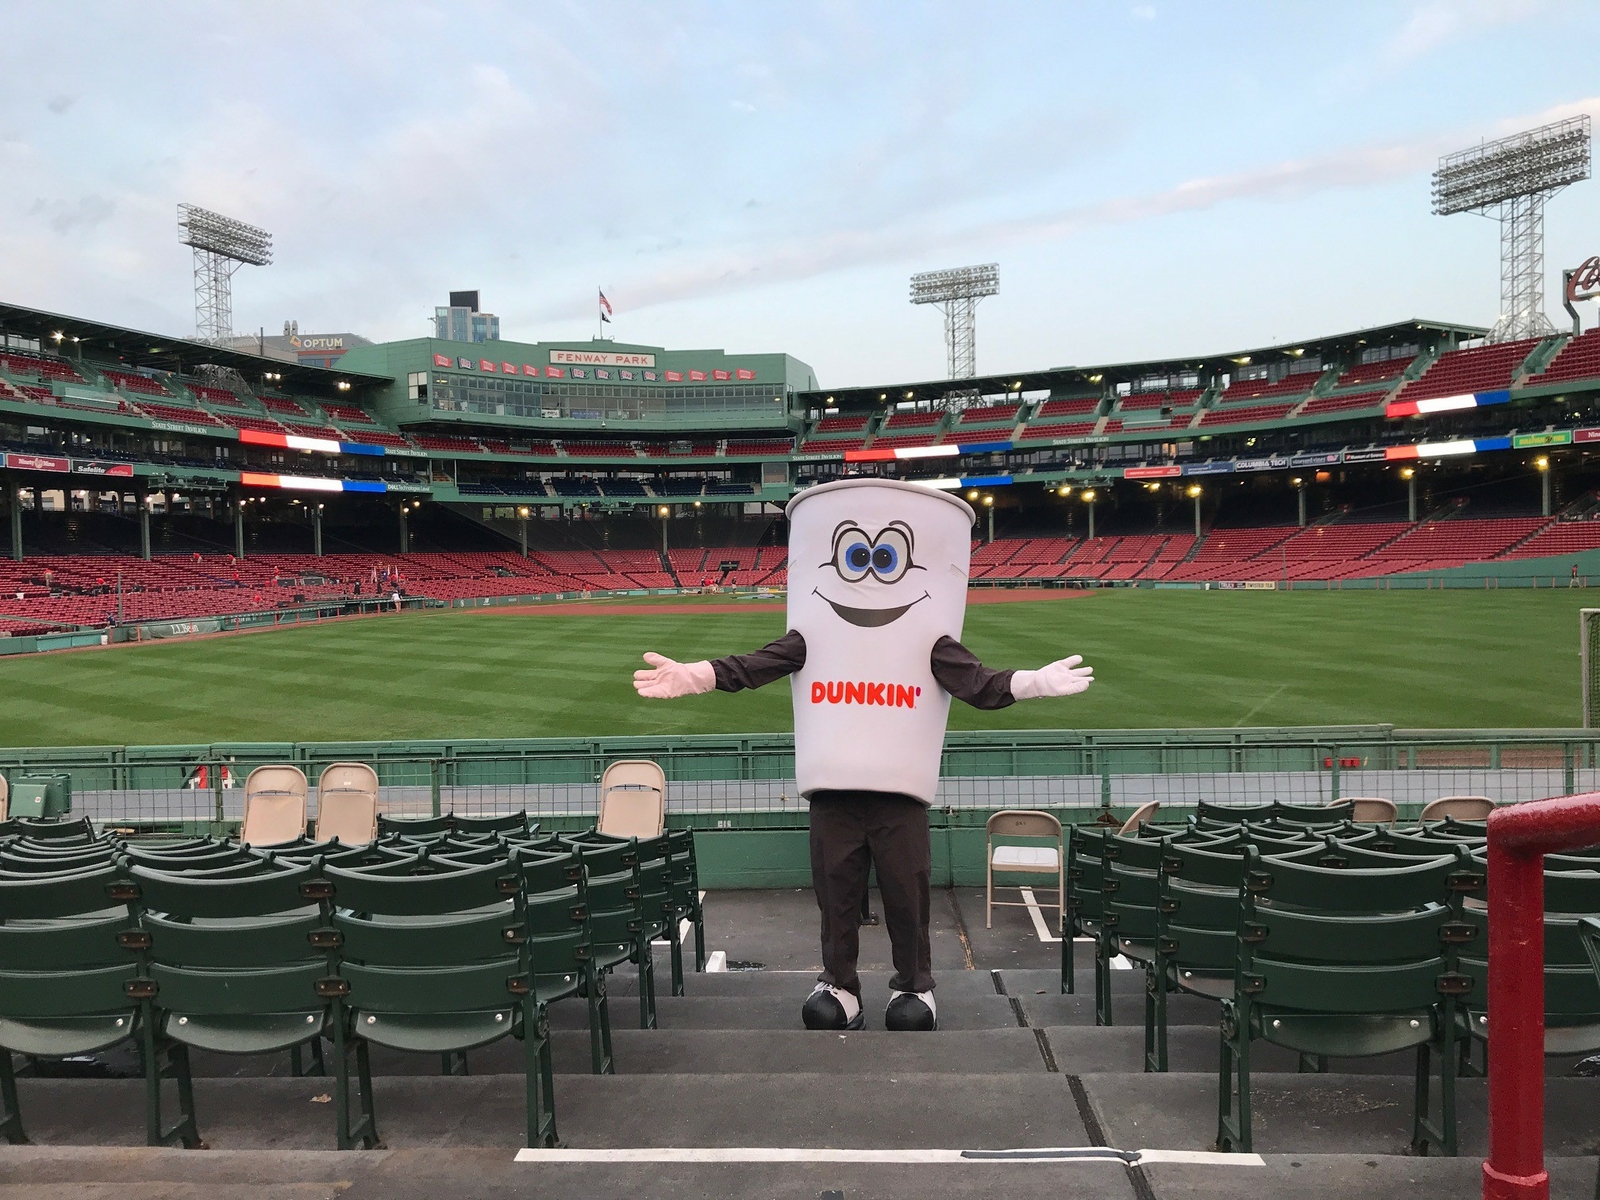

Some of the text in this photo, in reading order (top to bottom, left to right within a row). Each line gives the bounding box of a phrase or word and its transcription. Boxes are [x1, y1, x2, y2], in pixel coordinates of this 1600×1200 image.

[303, 337, 343, 348] OPTUM
[557, 353, 648, 365] FENWAY PARK
[167, 422, 184, 432] STREET
[185, 425, 207, 434] PAVILION
[1236, 459, 1286, 469] COLUMBIA TECH
[78, 466, 105, 474] Safelite
[811, 681, 921, 708] DUNKIN'
